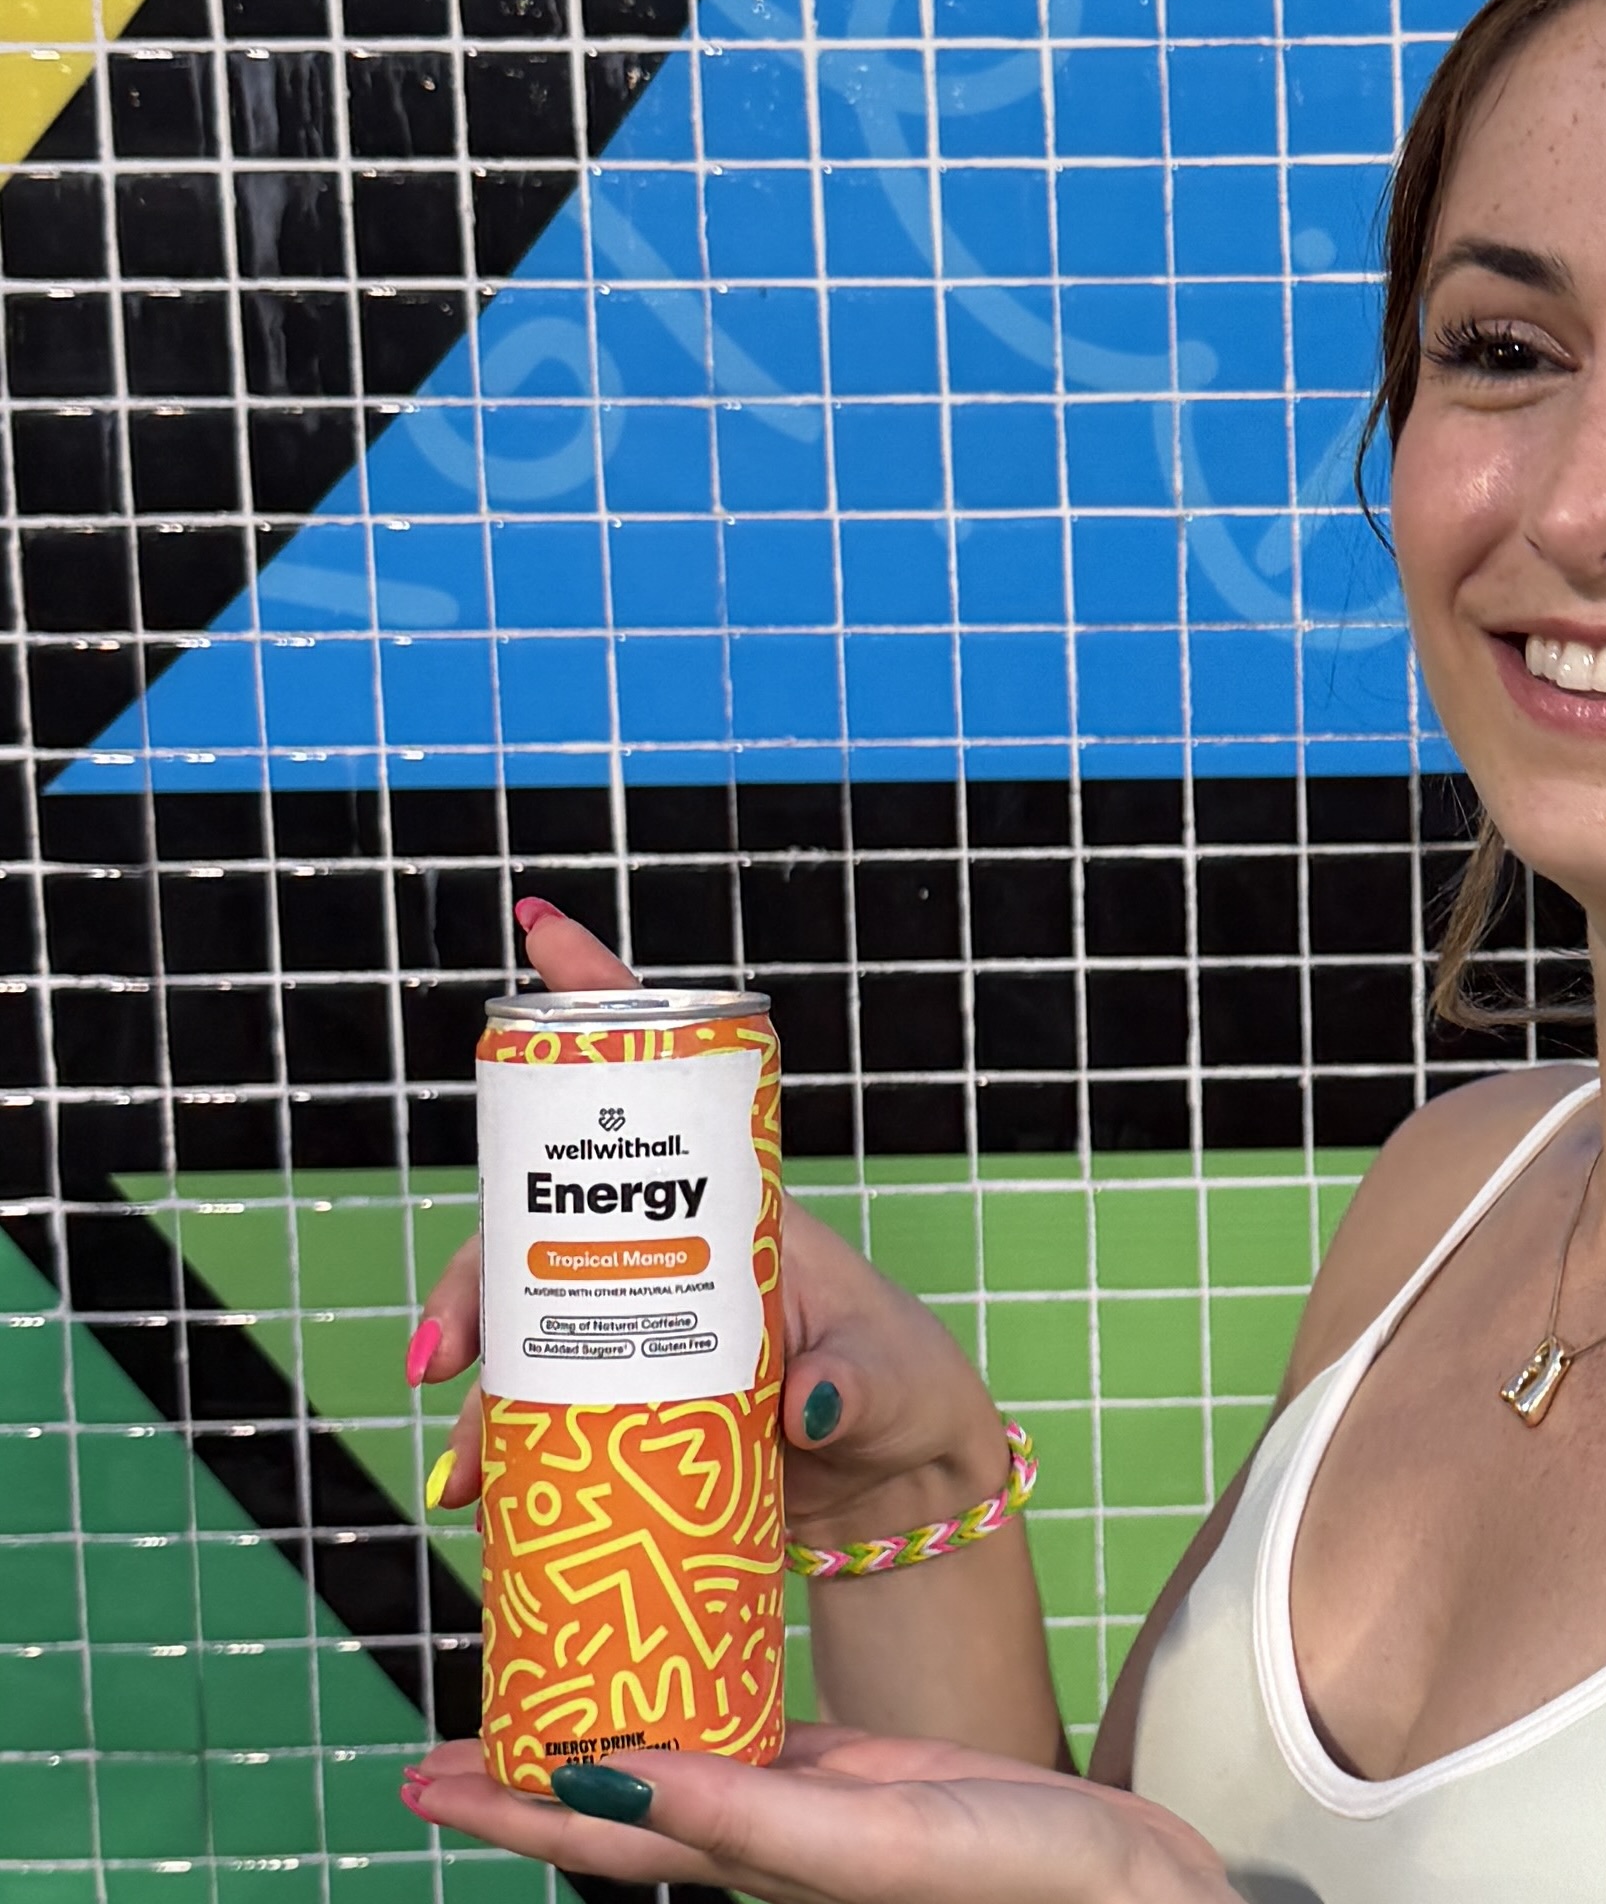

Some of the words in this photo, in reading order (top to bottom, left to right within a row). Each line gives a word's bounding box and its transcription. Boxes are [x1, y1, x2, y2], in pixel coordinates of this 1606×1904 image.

[528, 1172, 708, 1221] Energy
[547, 1251, 619, 1270] Tropical
[623, 1250, 688, 1269] Mango
[568, 1287, 592, 1297] WITH
[594, 1287, 627, 1297] OTHER
[629, 1285, 672, 1297] NATURAL
[675, 1281, 716, 1294] FLAVORS
[578, 1320, 591, 1331] of
[593, 1318, 639, 1332] Natural
[641, 1316, 693, 1330] Caffeine
[528, 1343, 543, 1353] No
[544, 1343, 579, 1355] Added
[649, 1340, 687, 1353] Gluten
[688, 1337, 713, 1350] Free
[545, 1739, 598, 1756] ENERGY
[600, 1731, 646, 1750] DRINK
